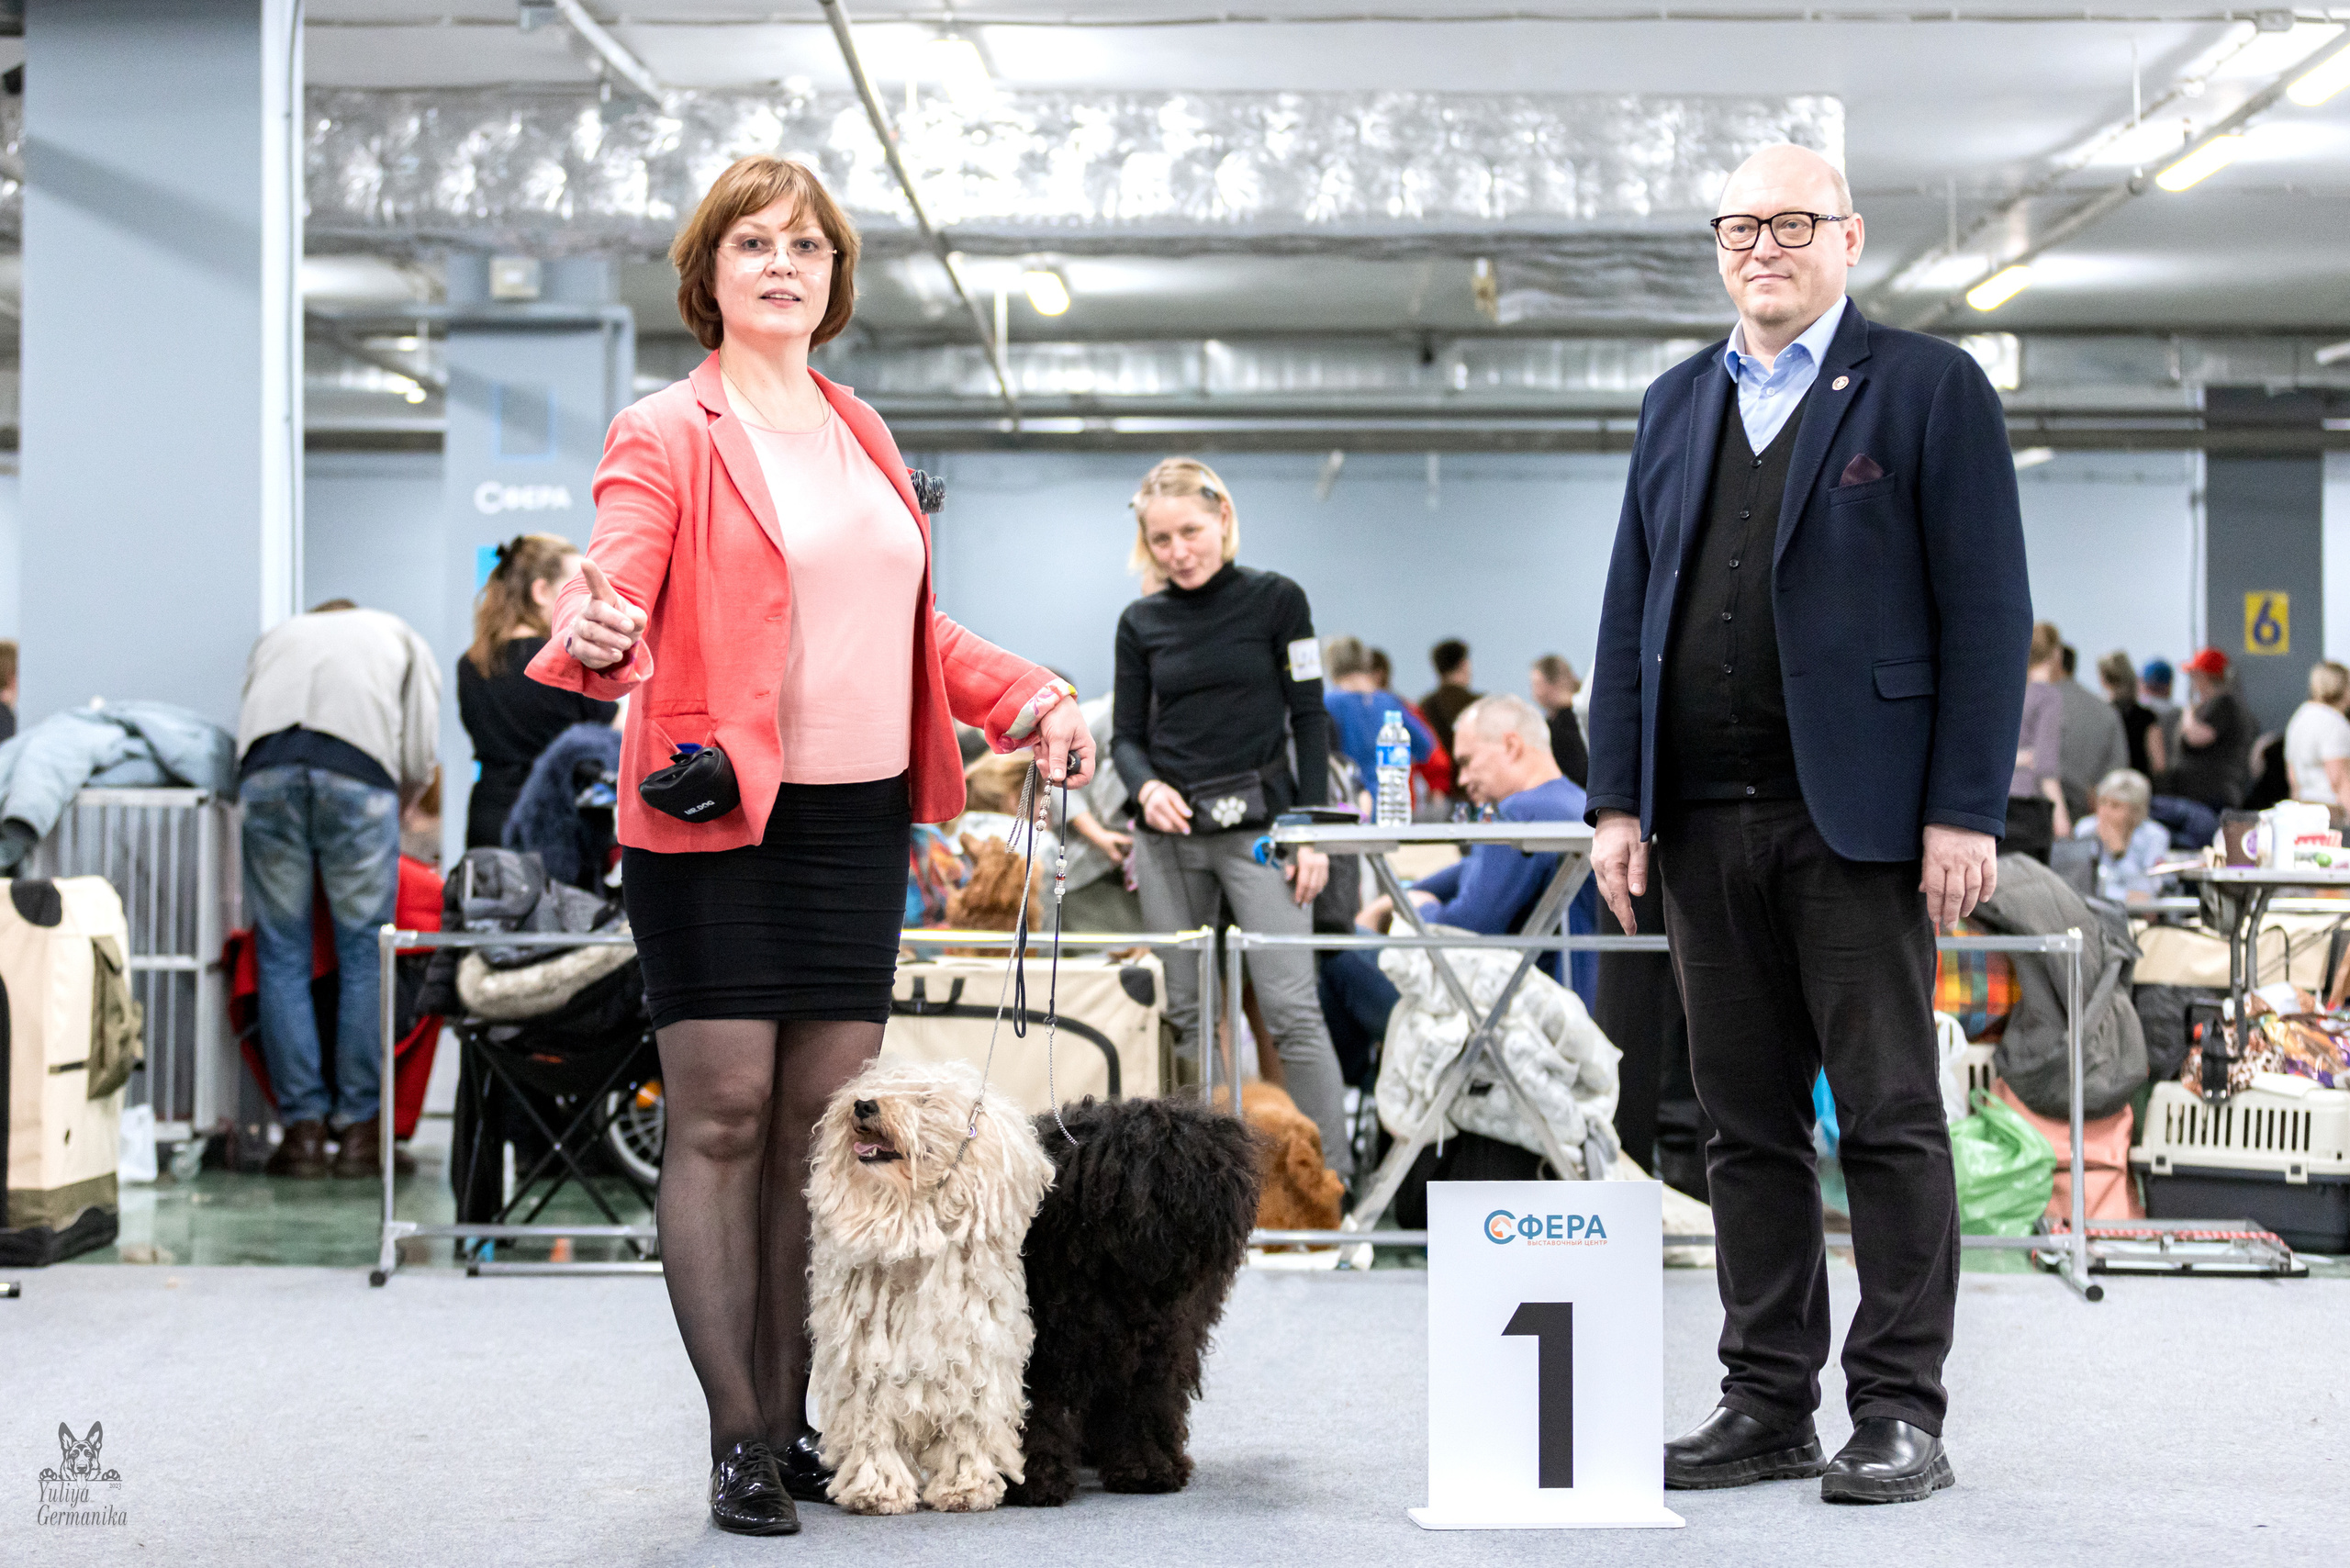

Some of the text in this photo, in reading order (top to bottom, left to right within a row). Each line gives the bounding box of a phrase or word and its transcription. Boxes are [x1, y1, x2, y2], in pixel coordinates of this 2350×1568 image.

[2253, 597, 2281, 645] 6
[1483, 1209, 1607, 1245] СФЕРА
[1501, 1302, 1573, 1489] 1
